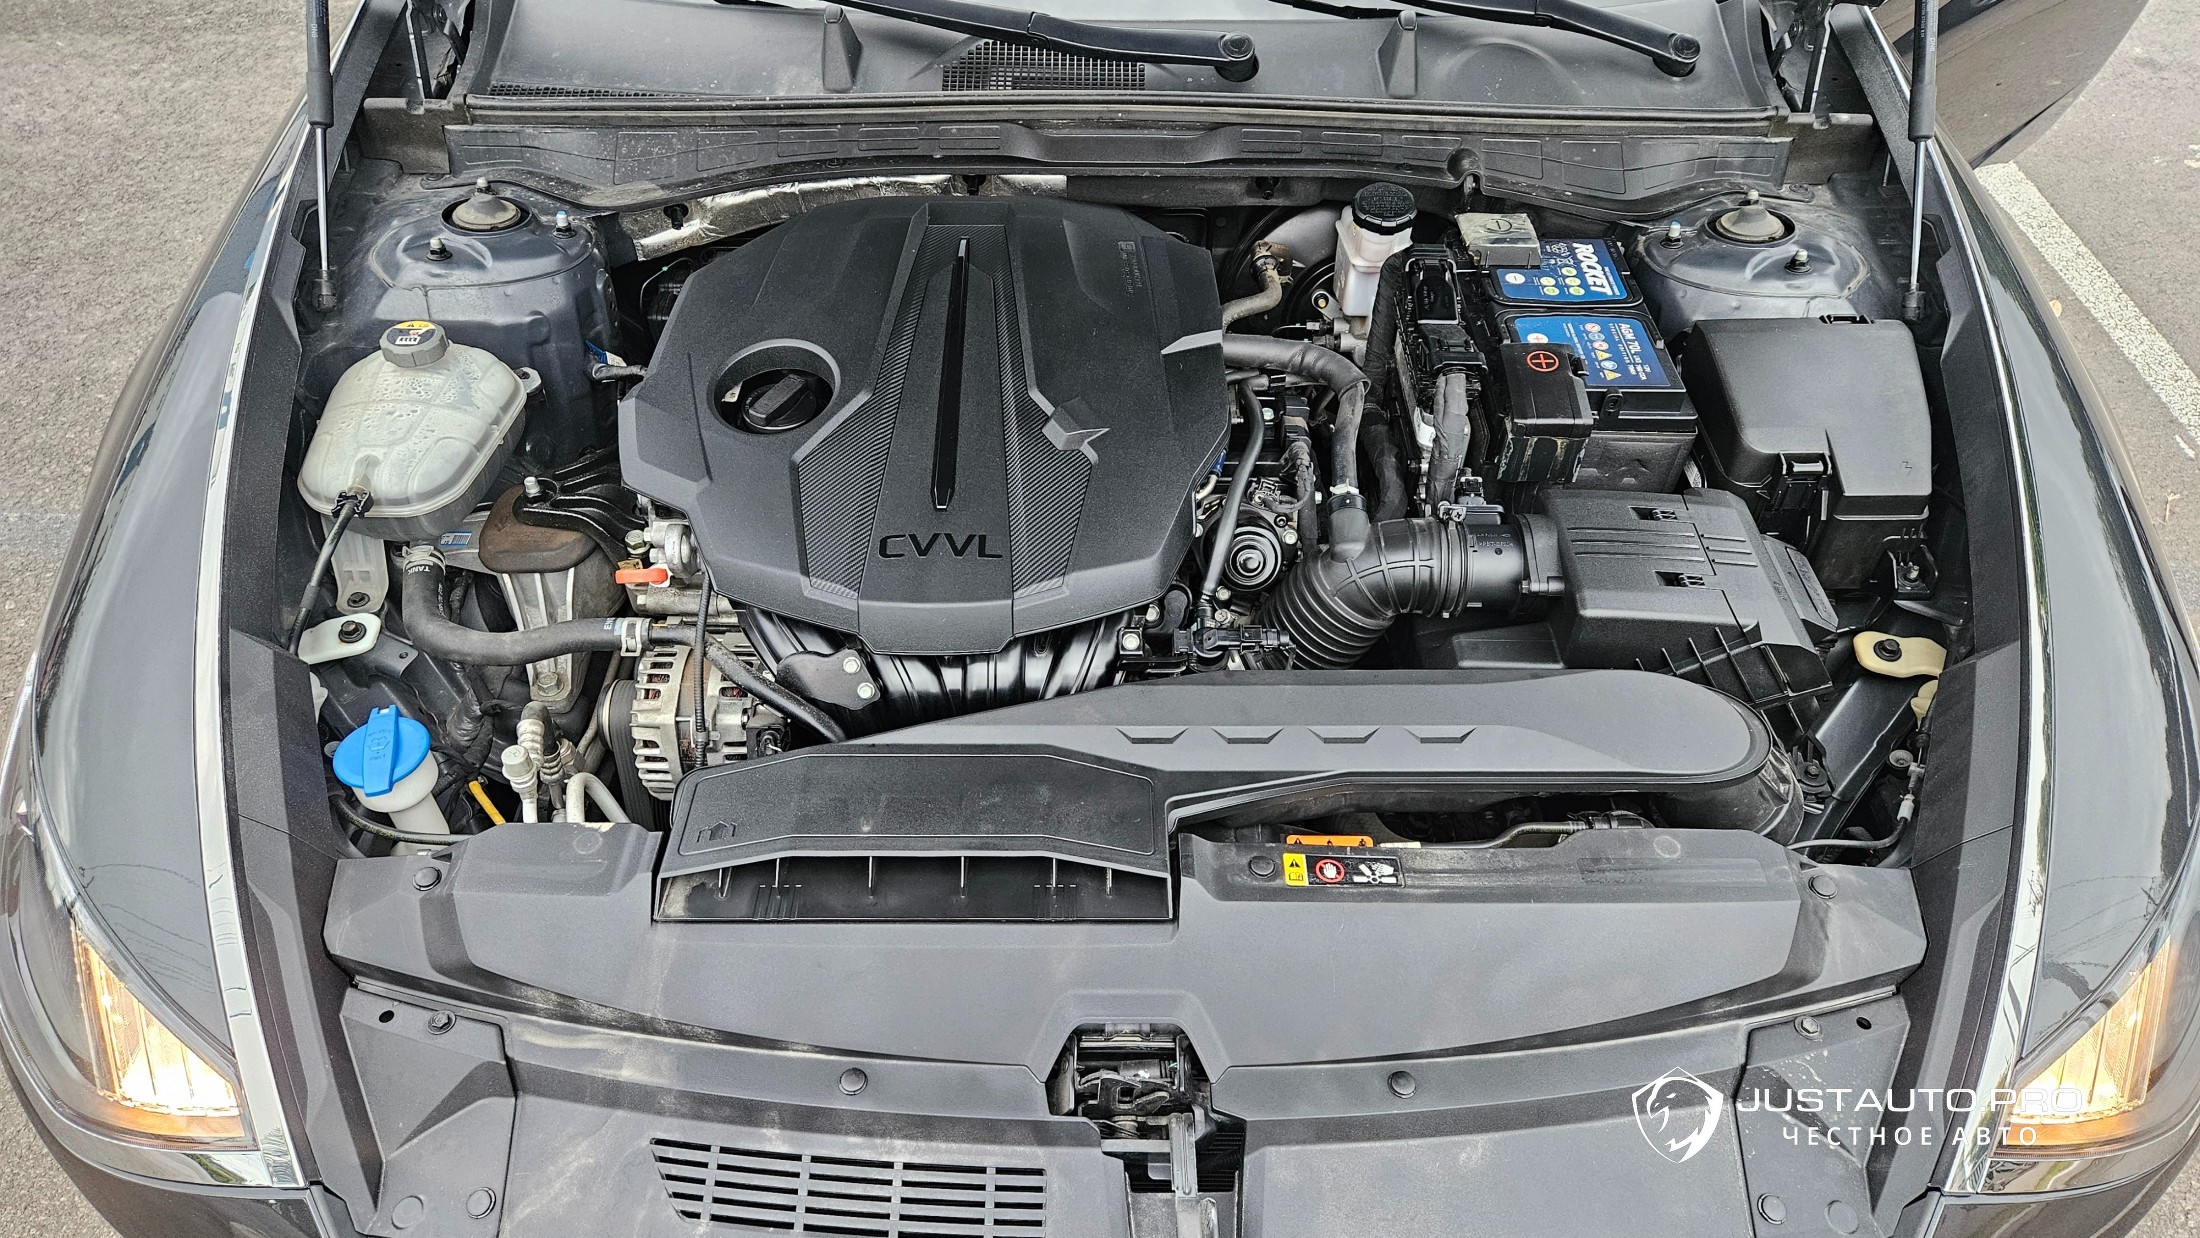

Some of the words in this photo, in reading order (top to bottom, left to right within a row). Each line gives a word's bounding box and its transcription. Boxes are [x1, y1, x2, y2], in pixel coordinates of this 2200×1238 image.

[1572, 242, 1614, 296] ROCKET
[1618, 323, 1636, 340] AGM
[1626, 340, 1642, 354] 70L
[878, 533, 1003, 559] CVVL
[407, 565, 431, 576] TANK
